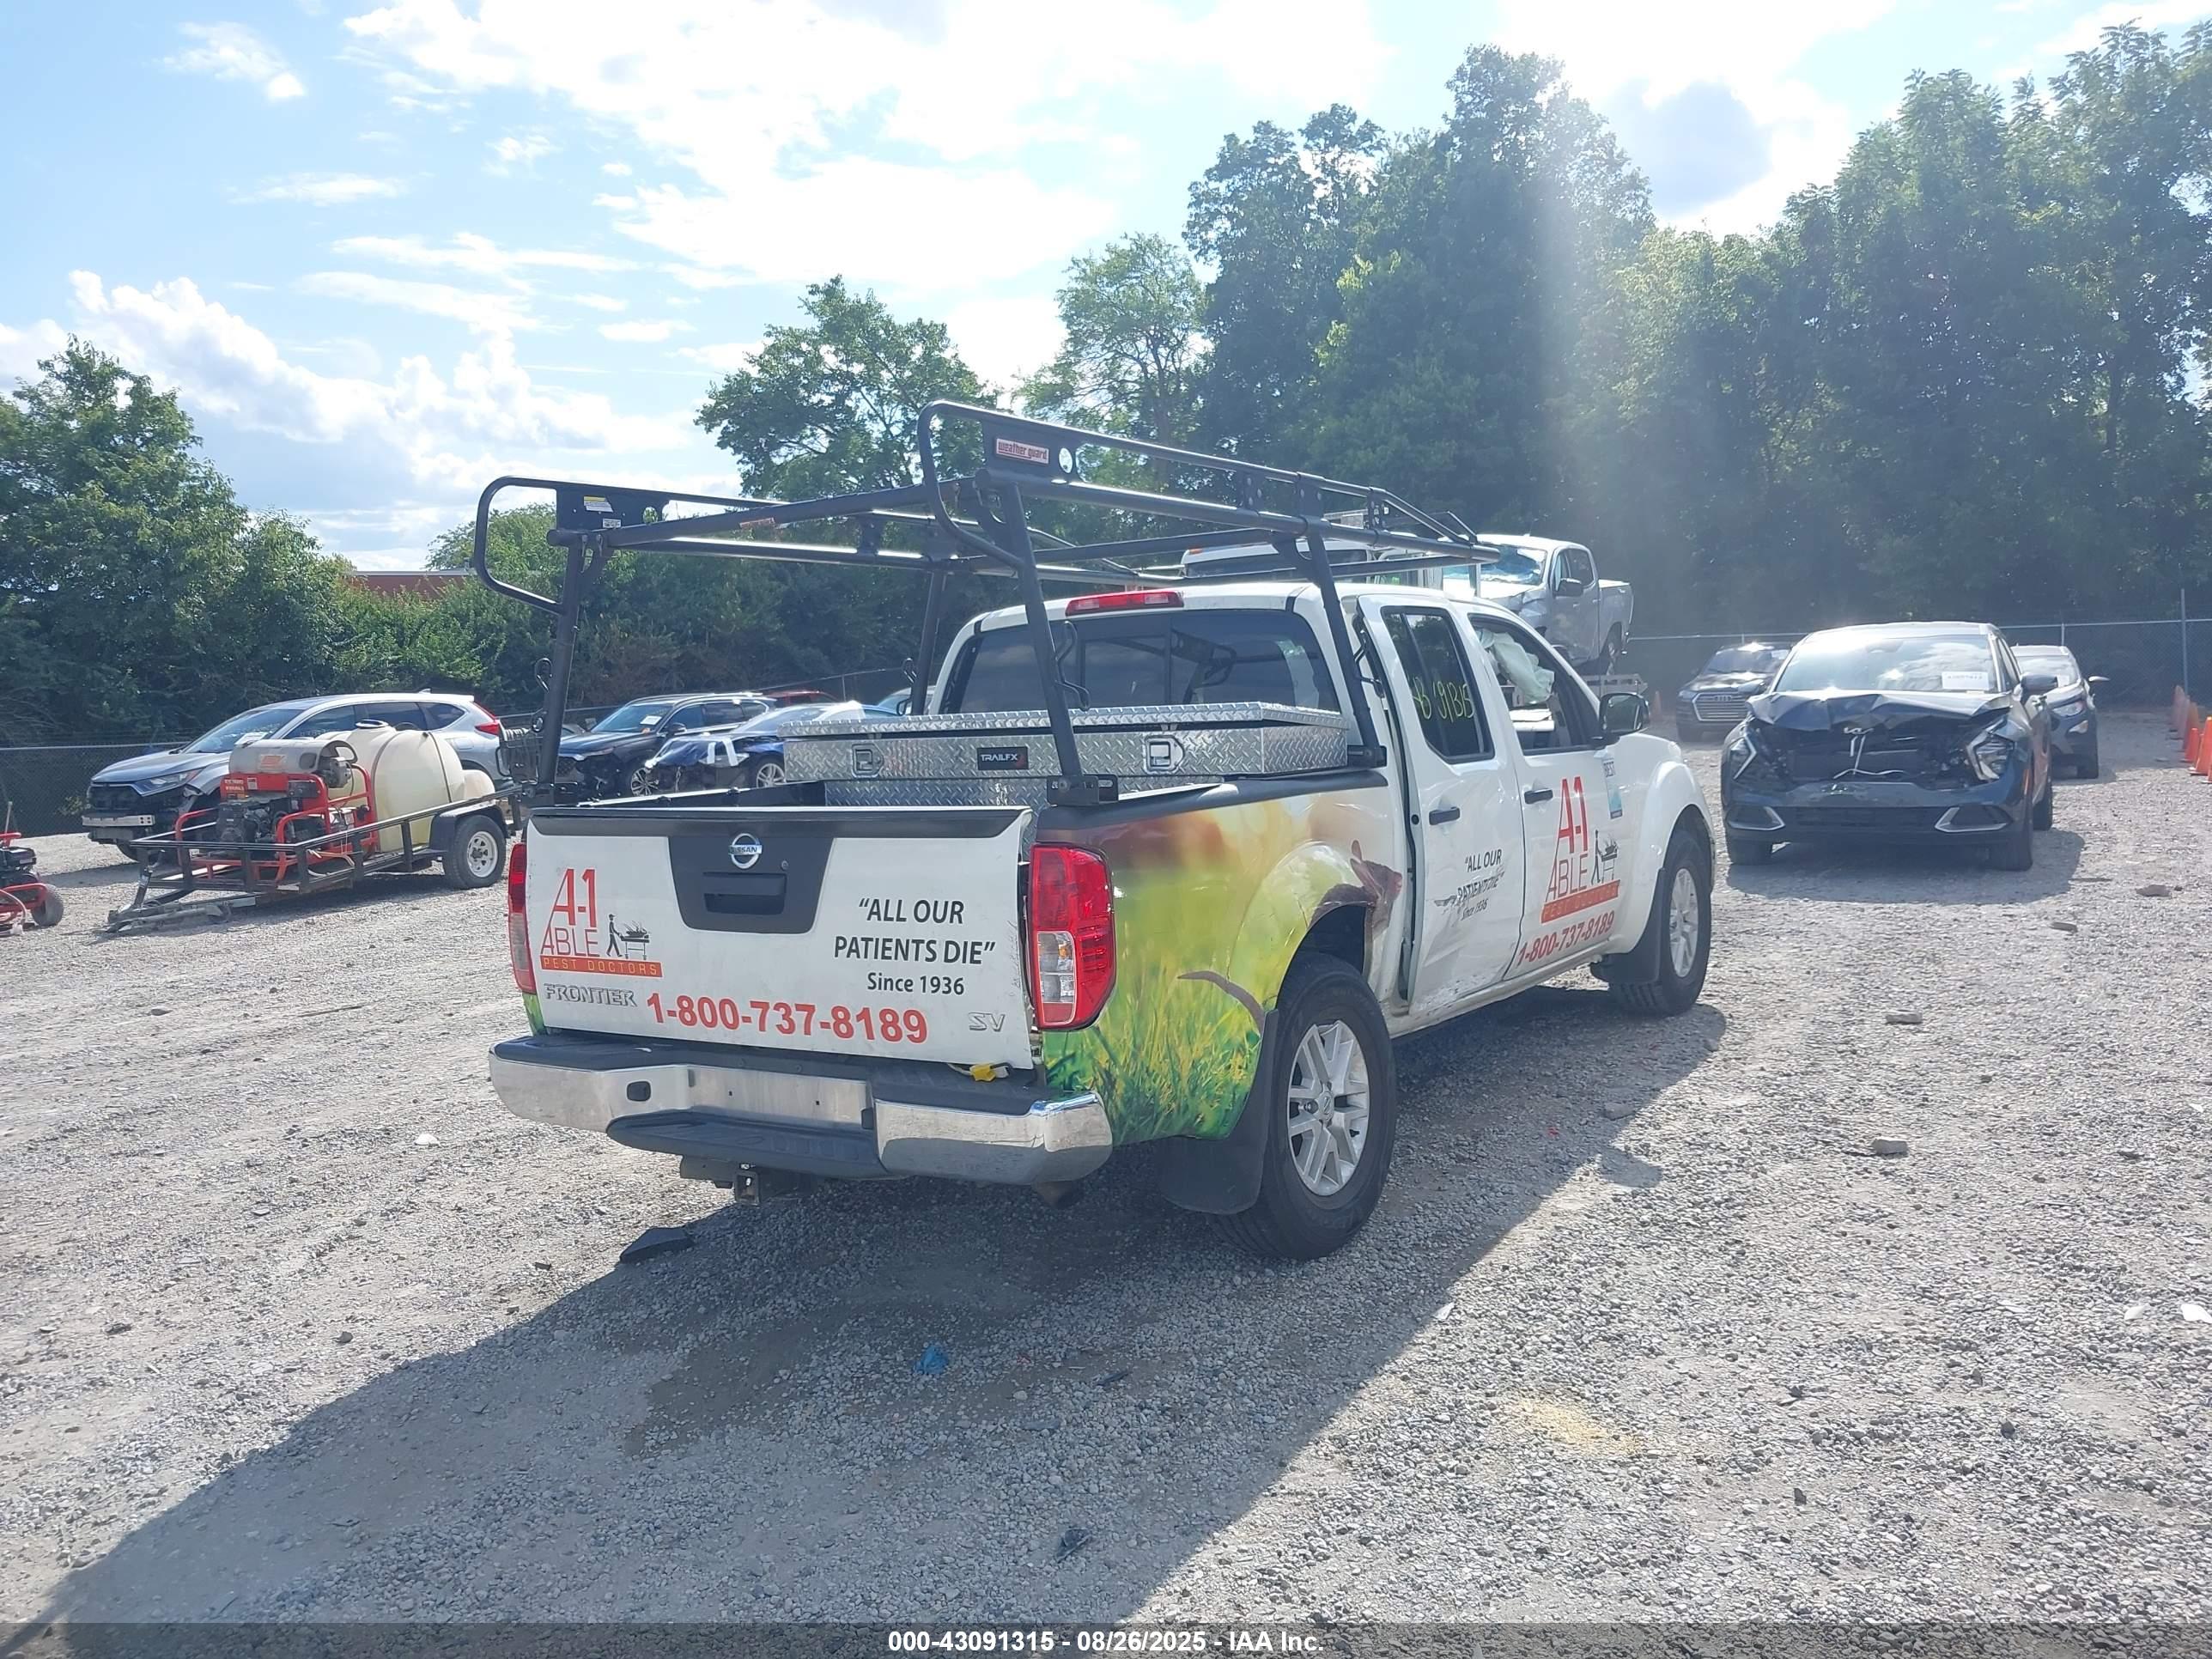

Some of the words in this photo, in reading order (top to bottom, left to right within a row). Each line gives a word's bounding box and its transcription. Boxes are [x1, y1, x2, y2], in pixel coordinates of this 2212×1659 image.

[980, 753, 1018, 762] TRAILFX
[1554, 775, 1589, 854] A-1
[1483, 848, 1502, 868] OUR
[1545, 854, 1589, 902] ABLE
[548, 868, 598, 928] A-1
[913, 899, 965, 925] OUR
[540, 924, 600, 958] ABLE
[834, 936, 938, 963] PATIENTS
[1517, 910, 1615, 969] 1-800-737-8189
[543, 957, 578, 969] PEST
[587, 959, 658, 975] DOCTORS
[543, 982, 638, 1008] FRONTIER
[866, 972, 915, 993] Since
[920, 975, 965, 996] 1936
[646, 992, 929, 1044] 1-800-737-8189
[968, 1012, 1006, 1032] SV
